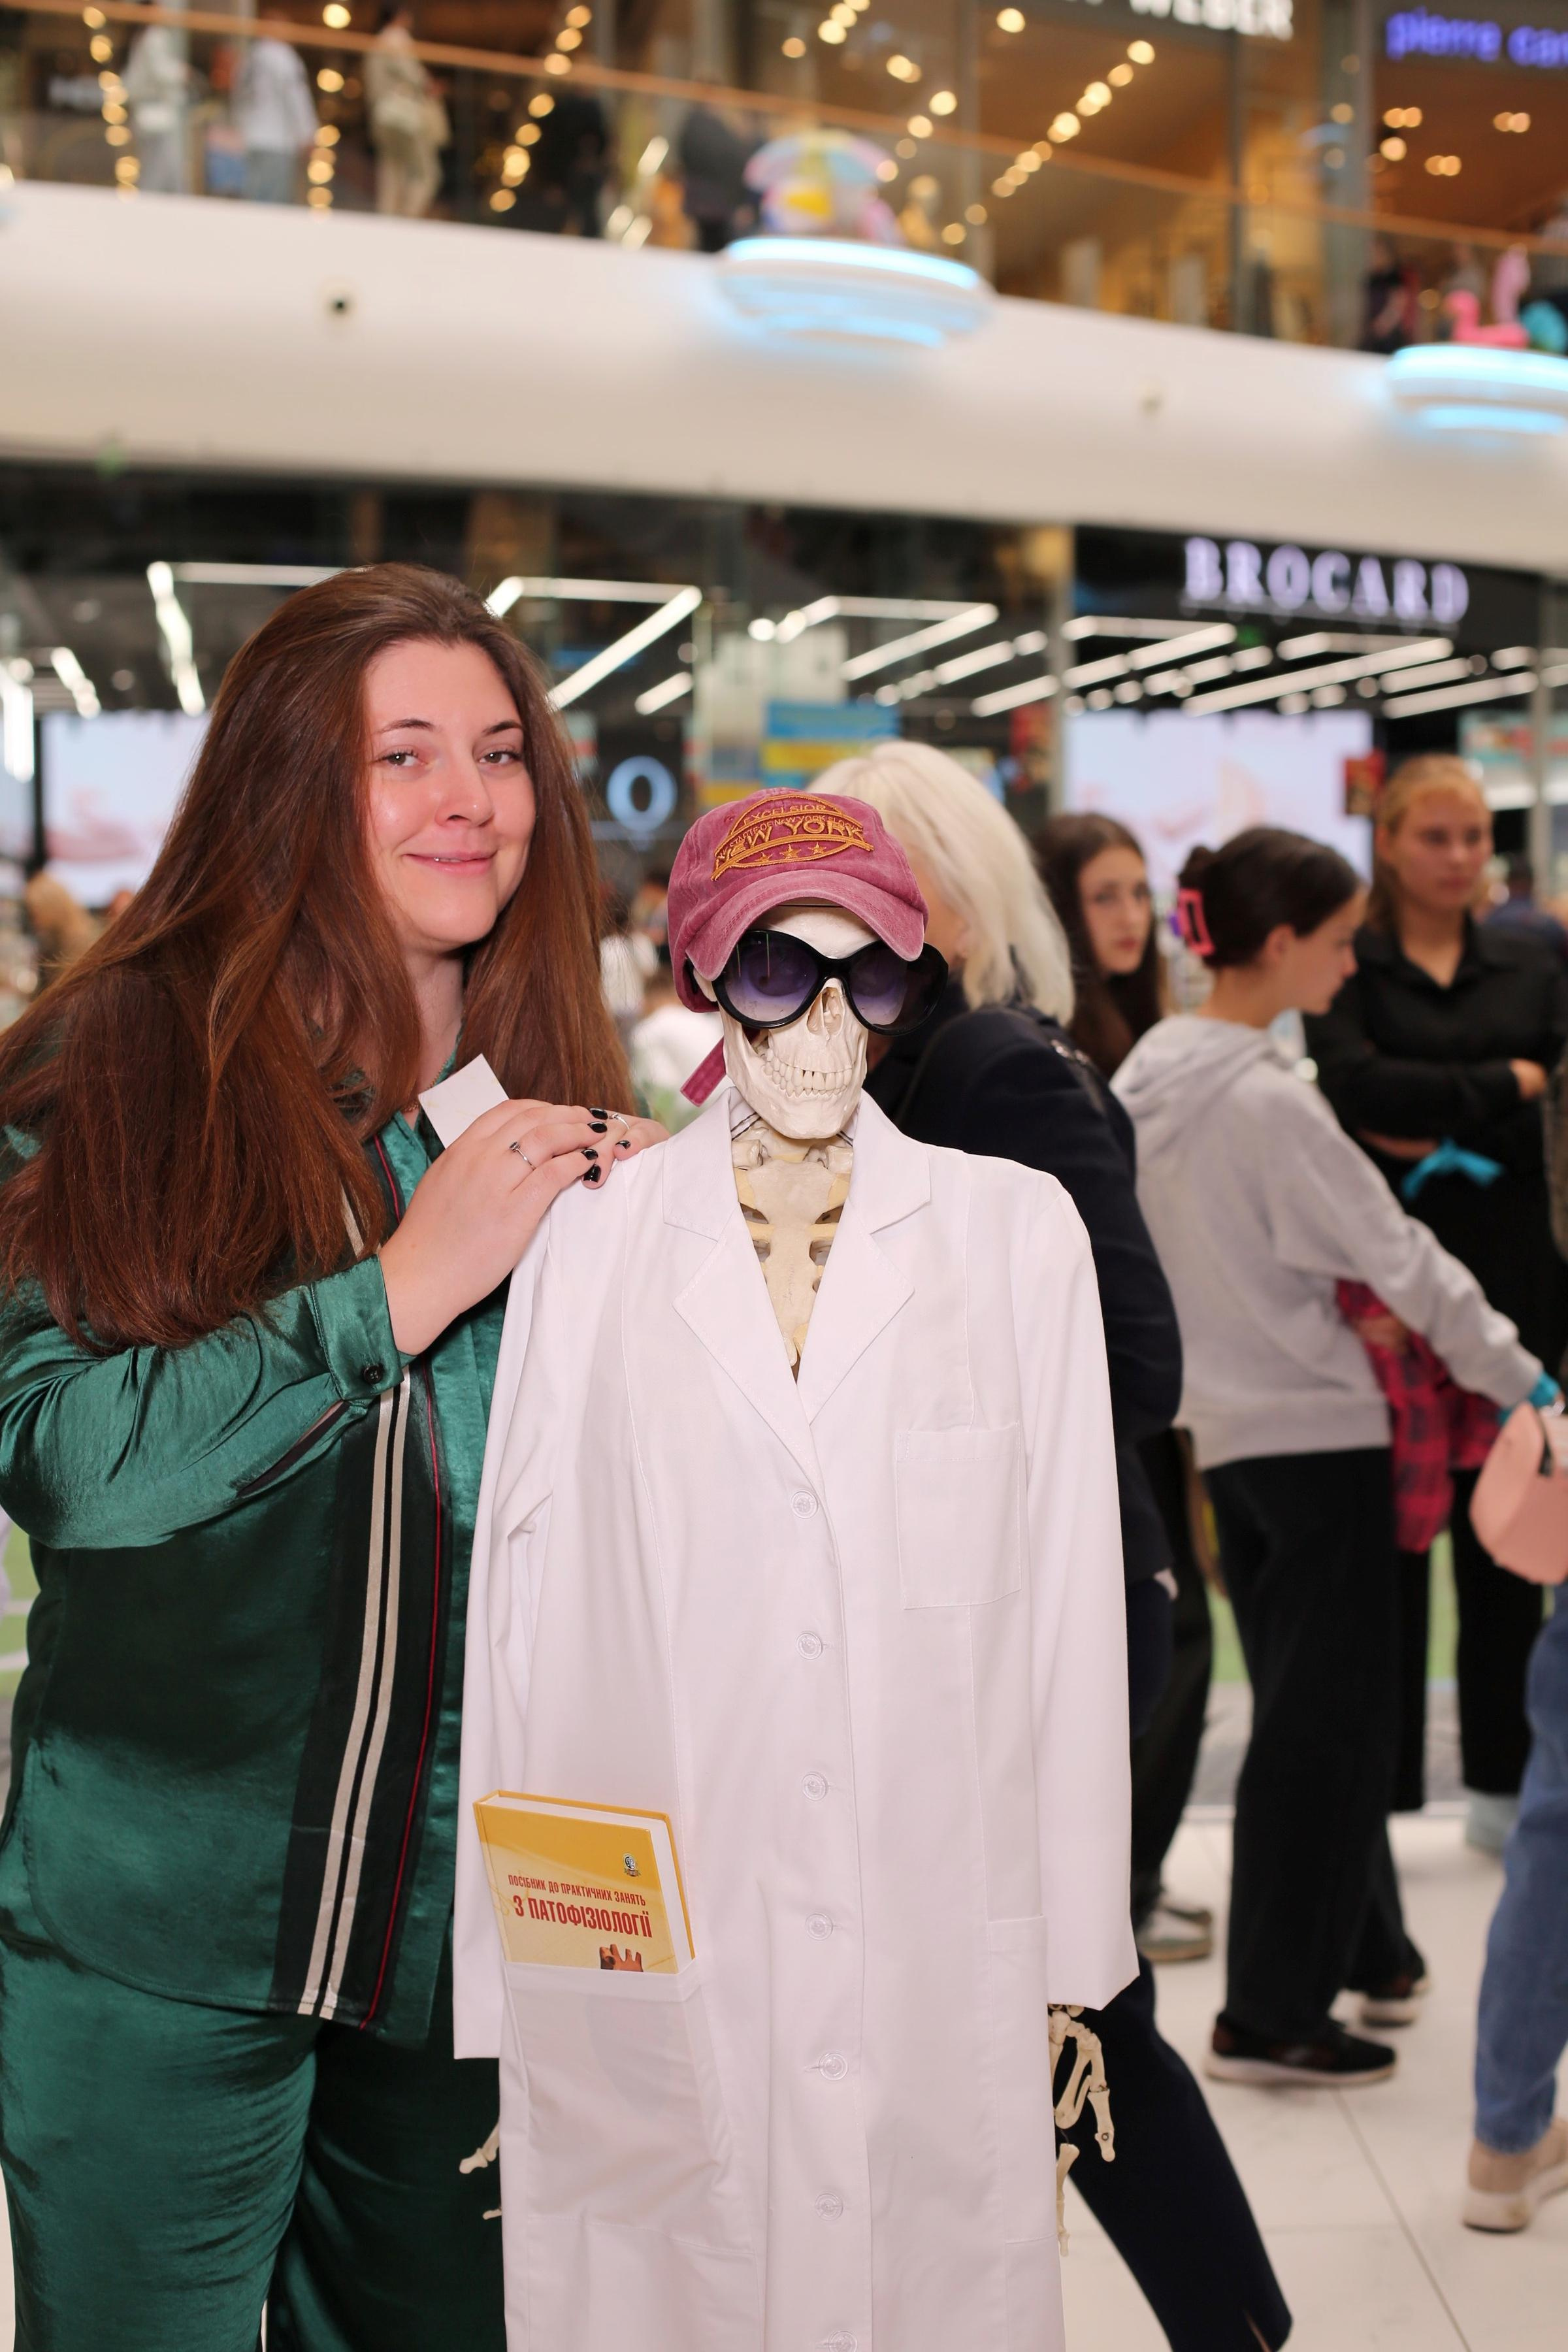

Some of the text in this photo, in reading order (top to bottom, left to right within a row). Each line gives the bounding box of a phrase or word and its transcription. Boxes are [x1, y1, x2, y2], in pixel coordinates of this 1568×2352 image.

[1183, 536, 1469, 625] BROCARD
[716, 819, 864, 870] NEW YORK
[508, 1874, 646, 1906] ПОСІБНИК ДО ПРАКТИЧНИХ ЗАНЯТЬ
[513, 1895, 653, 1938] З ПАТОФІЗІОЛОГІЇ
